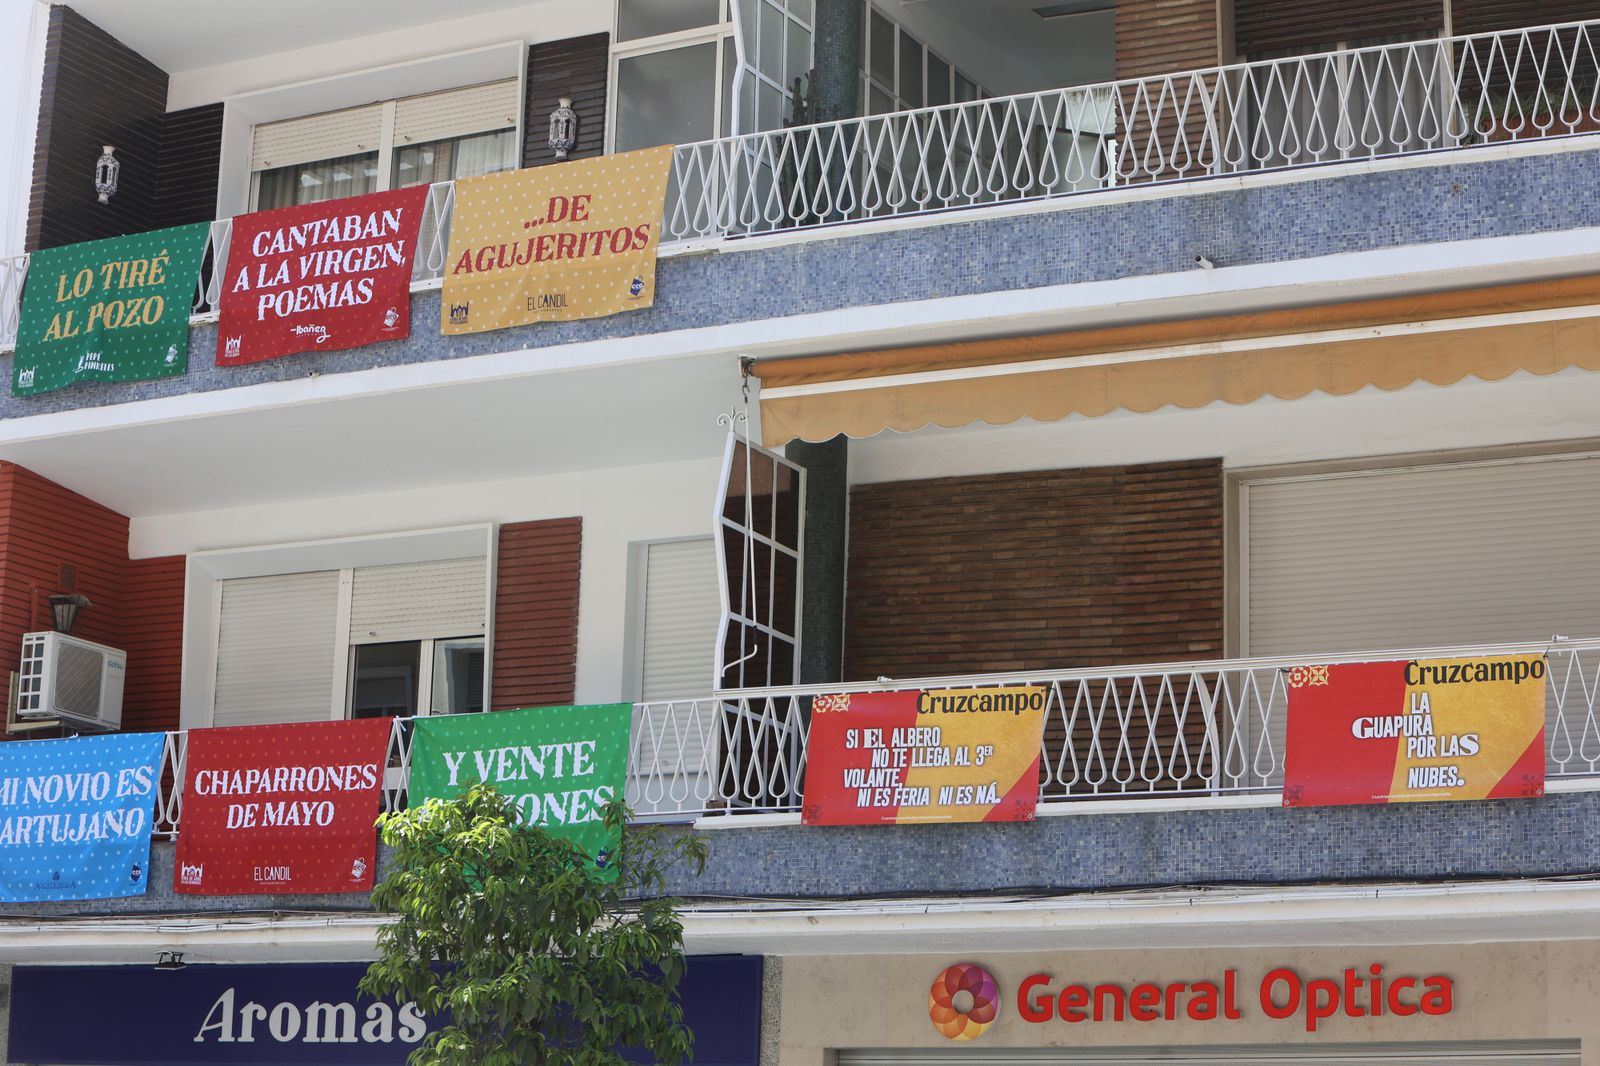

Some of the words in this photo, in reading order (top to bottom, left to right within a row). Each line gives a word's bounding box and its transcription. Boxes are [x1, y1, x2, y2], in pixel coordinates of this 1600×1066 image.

[252, 207, 403, 258] CANTABAN
[452, 223, 650, 275] AGUJERITOS
[56, 272, 94, 303] LO
[101, 249, 169, 290] TIRÉ
[232, 266, 250, 293] A
[257, 260, 290, 288] LA
[298, 240, 407, 280] VIRGEN,
[257, 277, 375, 321] POEMAS
[43, 309, 80, 342] AL
[85, 295, 164, 334] POZO
[1403, 659, 1545, 686] Cruzcampo
[917, 689, 1043, 716] Cruzcampo
[1411, 692, 1430, 714] LA
[845, 729, 859, 749] SI
[863, 728, 886, 749] EL
[891, 727, 941, 748] ALBERO
[1352, 714, 1434, 739] GUAPURA
[871, 748, 889, 769] NO
[892, 748, 907, 768] TE
[911, 746, 950, 767] LLEGA
[954, 746, 971, 766] AL
[1407, 736, 1437, 758] POR
[1440, 734, 1479, 757] LAS
[443, 751, 466, 786] Y
[473, 740, 596, 784] VENTE
[843, 768, 903, 789] VOLANTE,
[1407, 766, 1465, 789] NUBES.
[22, 771, 110, 804] NOVIO
[115, 765, 153, 798] ES
[194, 763, 377, 796] CHAPARRONES
[857, 788, 872, 808] NI
[873, 787, 891, 807] ES
[893, 786, 930, 807] FERIA
[939, 786, 954, 806] NI
[955, 786, 972, 805] ES
[0, 807, 145, 845] ARTUJANO
[226, 804, 255, 829] DE
[264, 800, 335, 827] MAYO
[253, 866, 263, 881] EL
[263, 866, 292, 881] CANDIL
[1017, 970, 1241, 1024] General
[1259, 963, 1454, 1031] Optica
[193, 988, 428, 1044] Aromas
